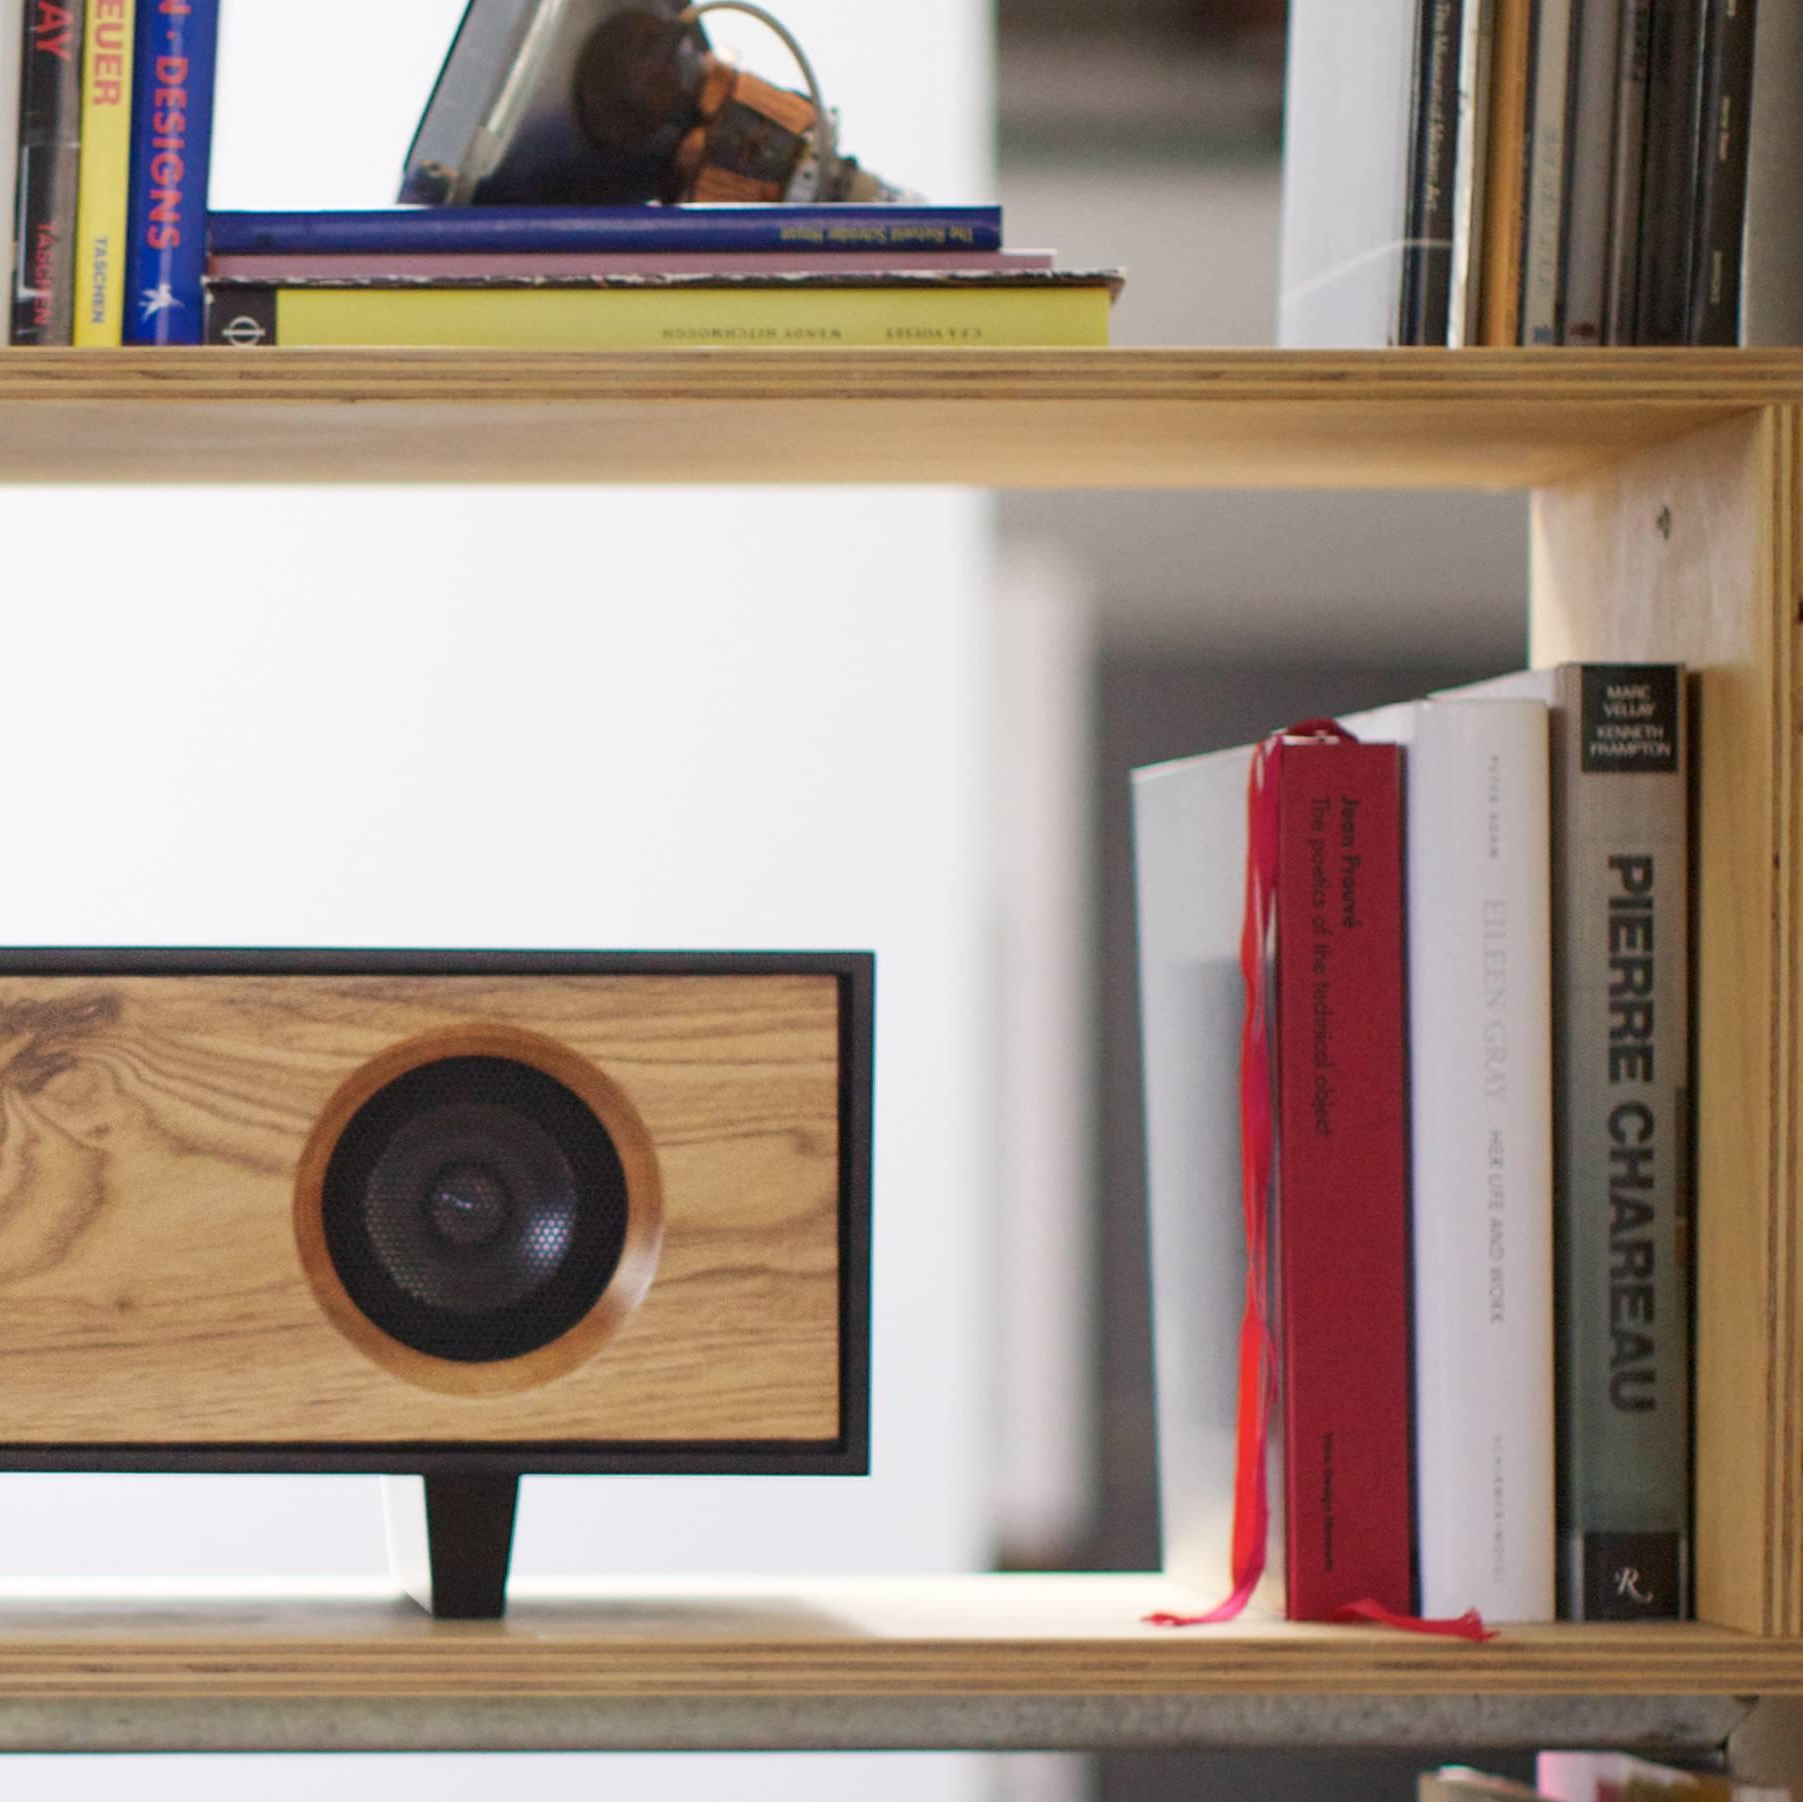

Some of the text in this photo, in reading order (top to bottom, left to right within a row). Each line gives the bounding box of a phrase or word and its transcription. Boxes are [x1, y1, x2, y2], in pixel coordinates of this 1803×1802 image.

[147, 56, 188, 249] DESIGNS
[34, 222, 54, 325] TASCHEN
[92, 237, 108, 323] TASCHEN
[1341, 794, 1362, 929] Jean Prouvé
[1308, 796, 1333, 1136] The poetics of the technical object
[1482, 899, 1507, 1101] EILEEN GRAY
[1606, 854, 1656, 1413] PIERRE CHAREAU
